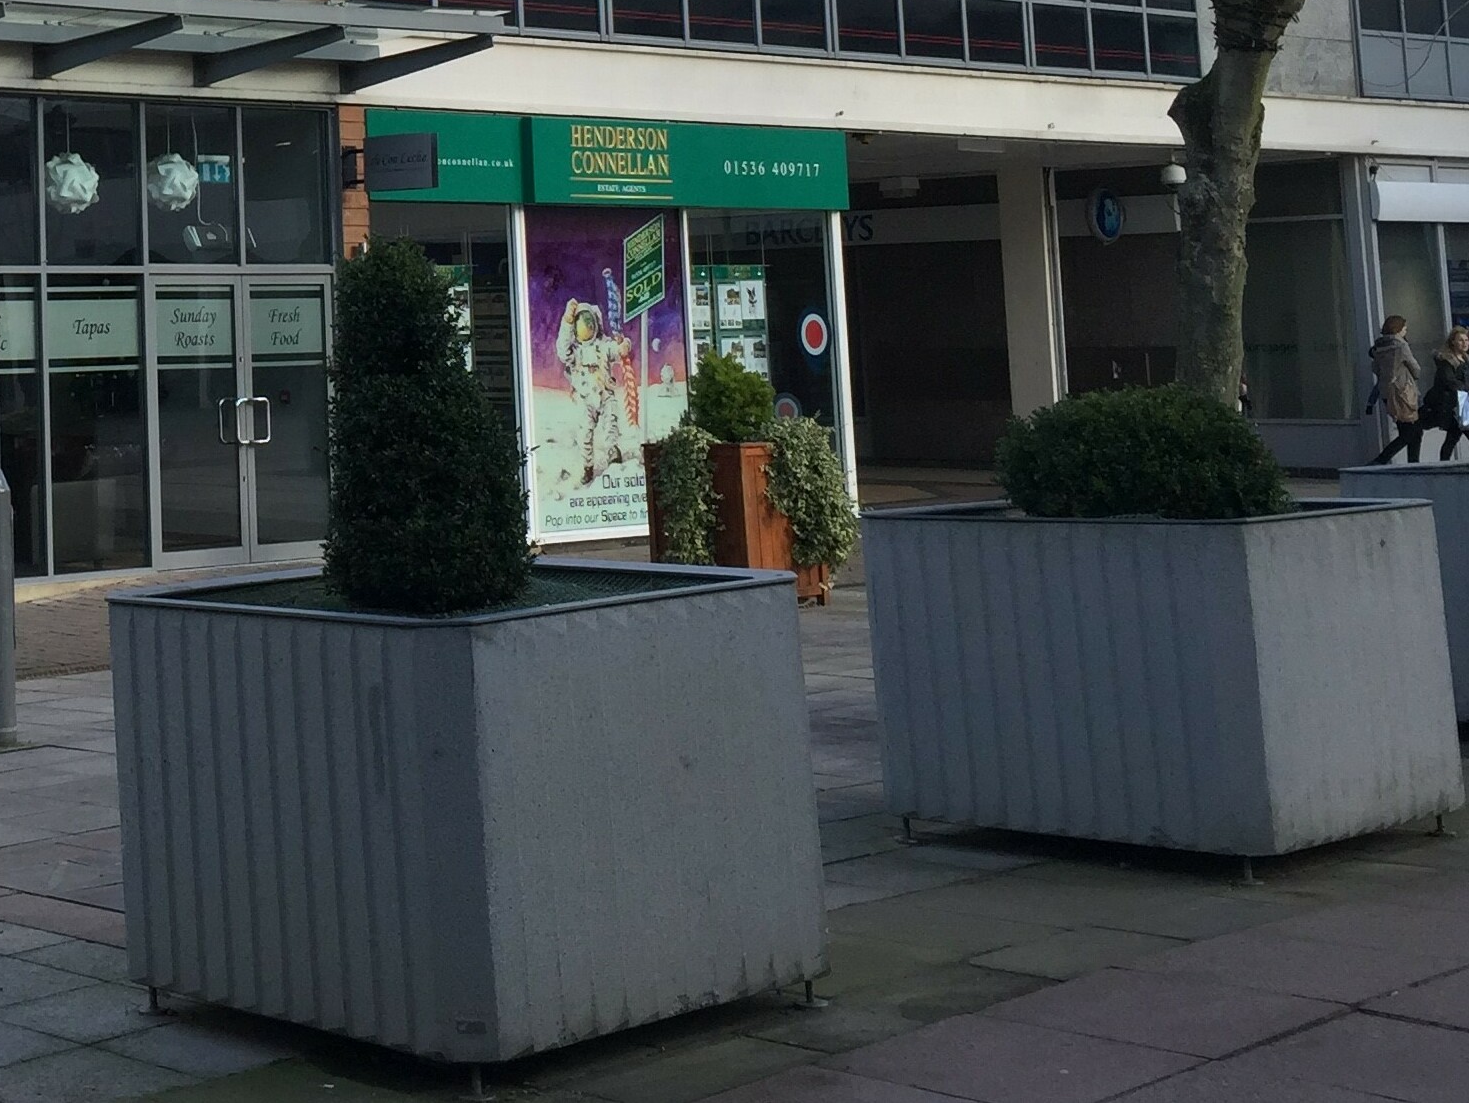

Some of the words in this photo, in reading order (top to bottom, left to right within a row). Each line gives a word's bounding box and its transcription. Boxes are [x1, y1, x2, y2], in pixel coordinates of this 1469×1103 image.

[570, 124, 668, 151] HENDERSON
[572, 150, 670, 176] CONNELLAN
[723, 159, 766, 176] 01536
[771, 161, 820, 177] 409717
[597, 184, 621, 192] ESTATE
[621, 185, 646, 193] AGENTS
[745, 214, 875, 246] BARCLYS
[626, 271, 663, 304] SOLD
[170, 305, 218, 326] Sunday
[268, 306, 301, 325] Fresh
[72, 318, 112, 340] Tapas
[270, 328, 300, 347] Food
[173, 330, 216, 348] Roasts
[602, 474, 621, 489] Our
[569, 497, 584, 508] are
[586, 493, 630, 507] appearing
[545, 514, 563, 528] Pop
[565, 516, 582, 526] into
[601, 509, 627, 523] Space
